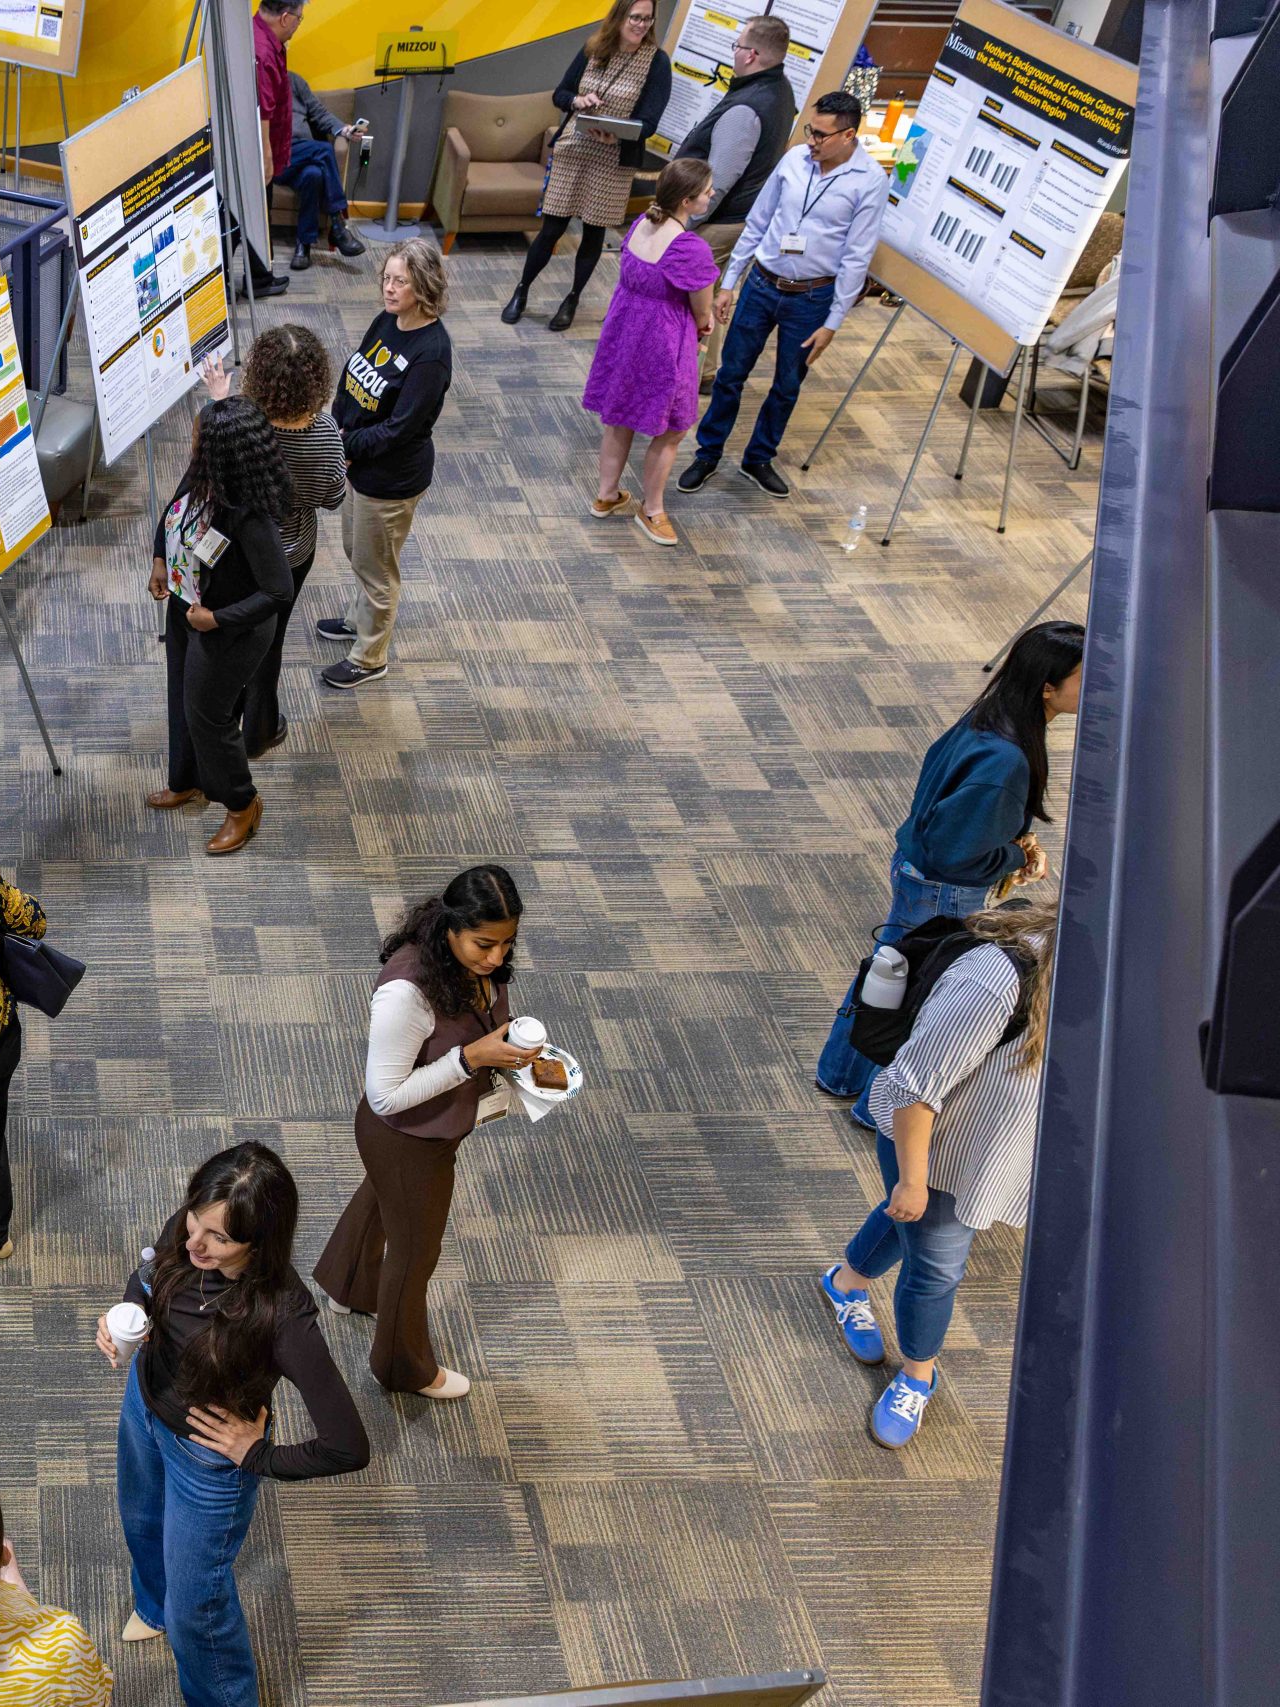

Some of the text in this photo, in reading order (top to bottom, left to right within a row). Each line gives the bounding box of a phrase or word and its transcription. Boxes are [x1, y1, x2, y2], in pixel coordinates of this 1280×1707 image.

[397, 41, 437, 52] MIZZOU
[946, 31, 978, 60] Mizzou
[975, 50, 1122, 135] the Saber 11 Test: Evidence from Colombia's
[983, 40, 1126, 121] Mother's Background and Gender Gaps in
[1011, 83, 1068, 122] Amazon Region
[140, 171, 166, 198] Understanding
[365, 339, 383, 359] I
